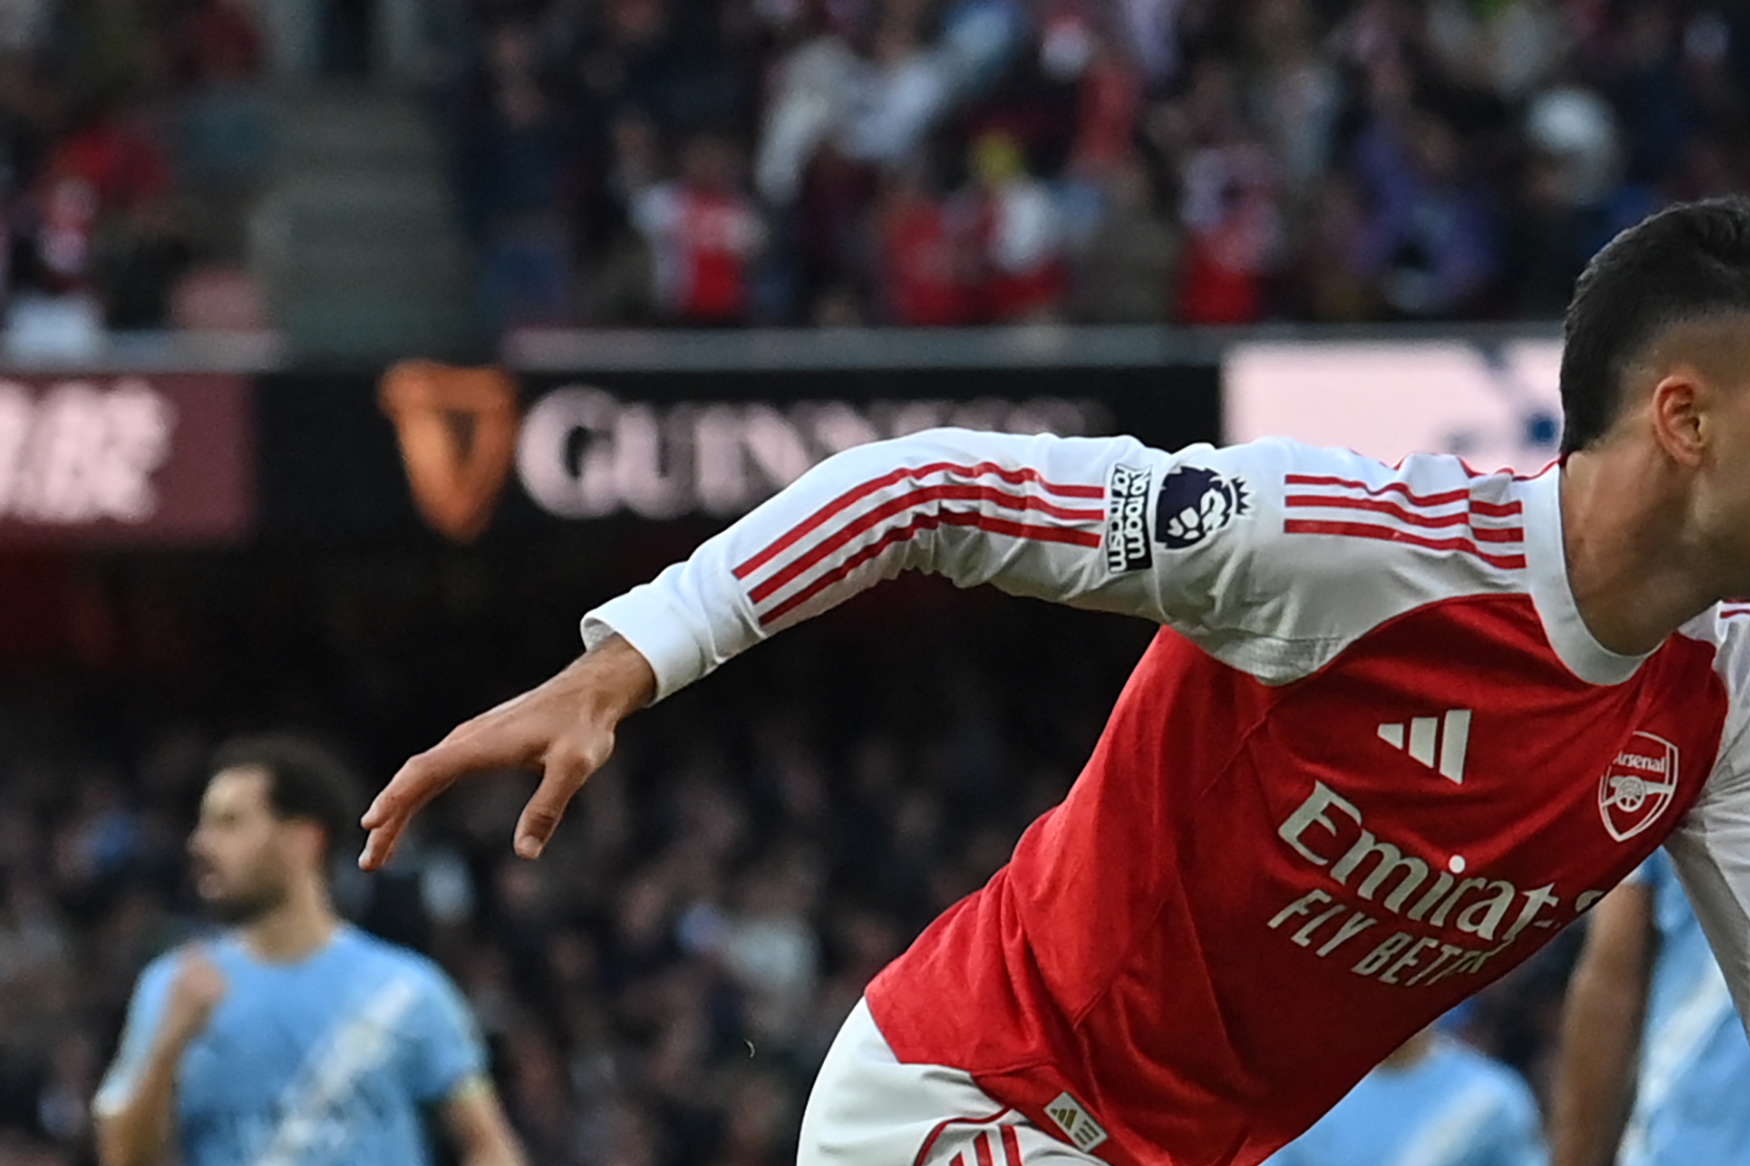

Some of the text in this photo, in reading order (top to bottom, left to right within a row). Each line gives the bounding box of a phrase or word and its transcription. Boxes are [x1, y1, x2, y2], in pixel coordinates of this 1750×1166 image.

[1108, 497, 1127, 572] racism
[1125, 496, 1146, 560] room
[1277, 780, 1604, 942] Emirat
[1267, 888, 1378, 957] FLY
